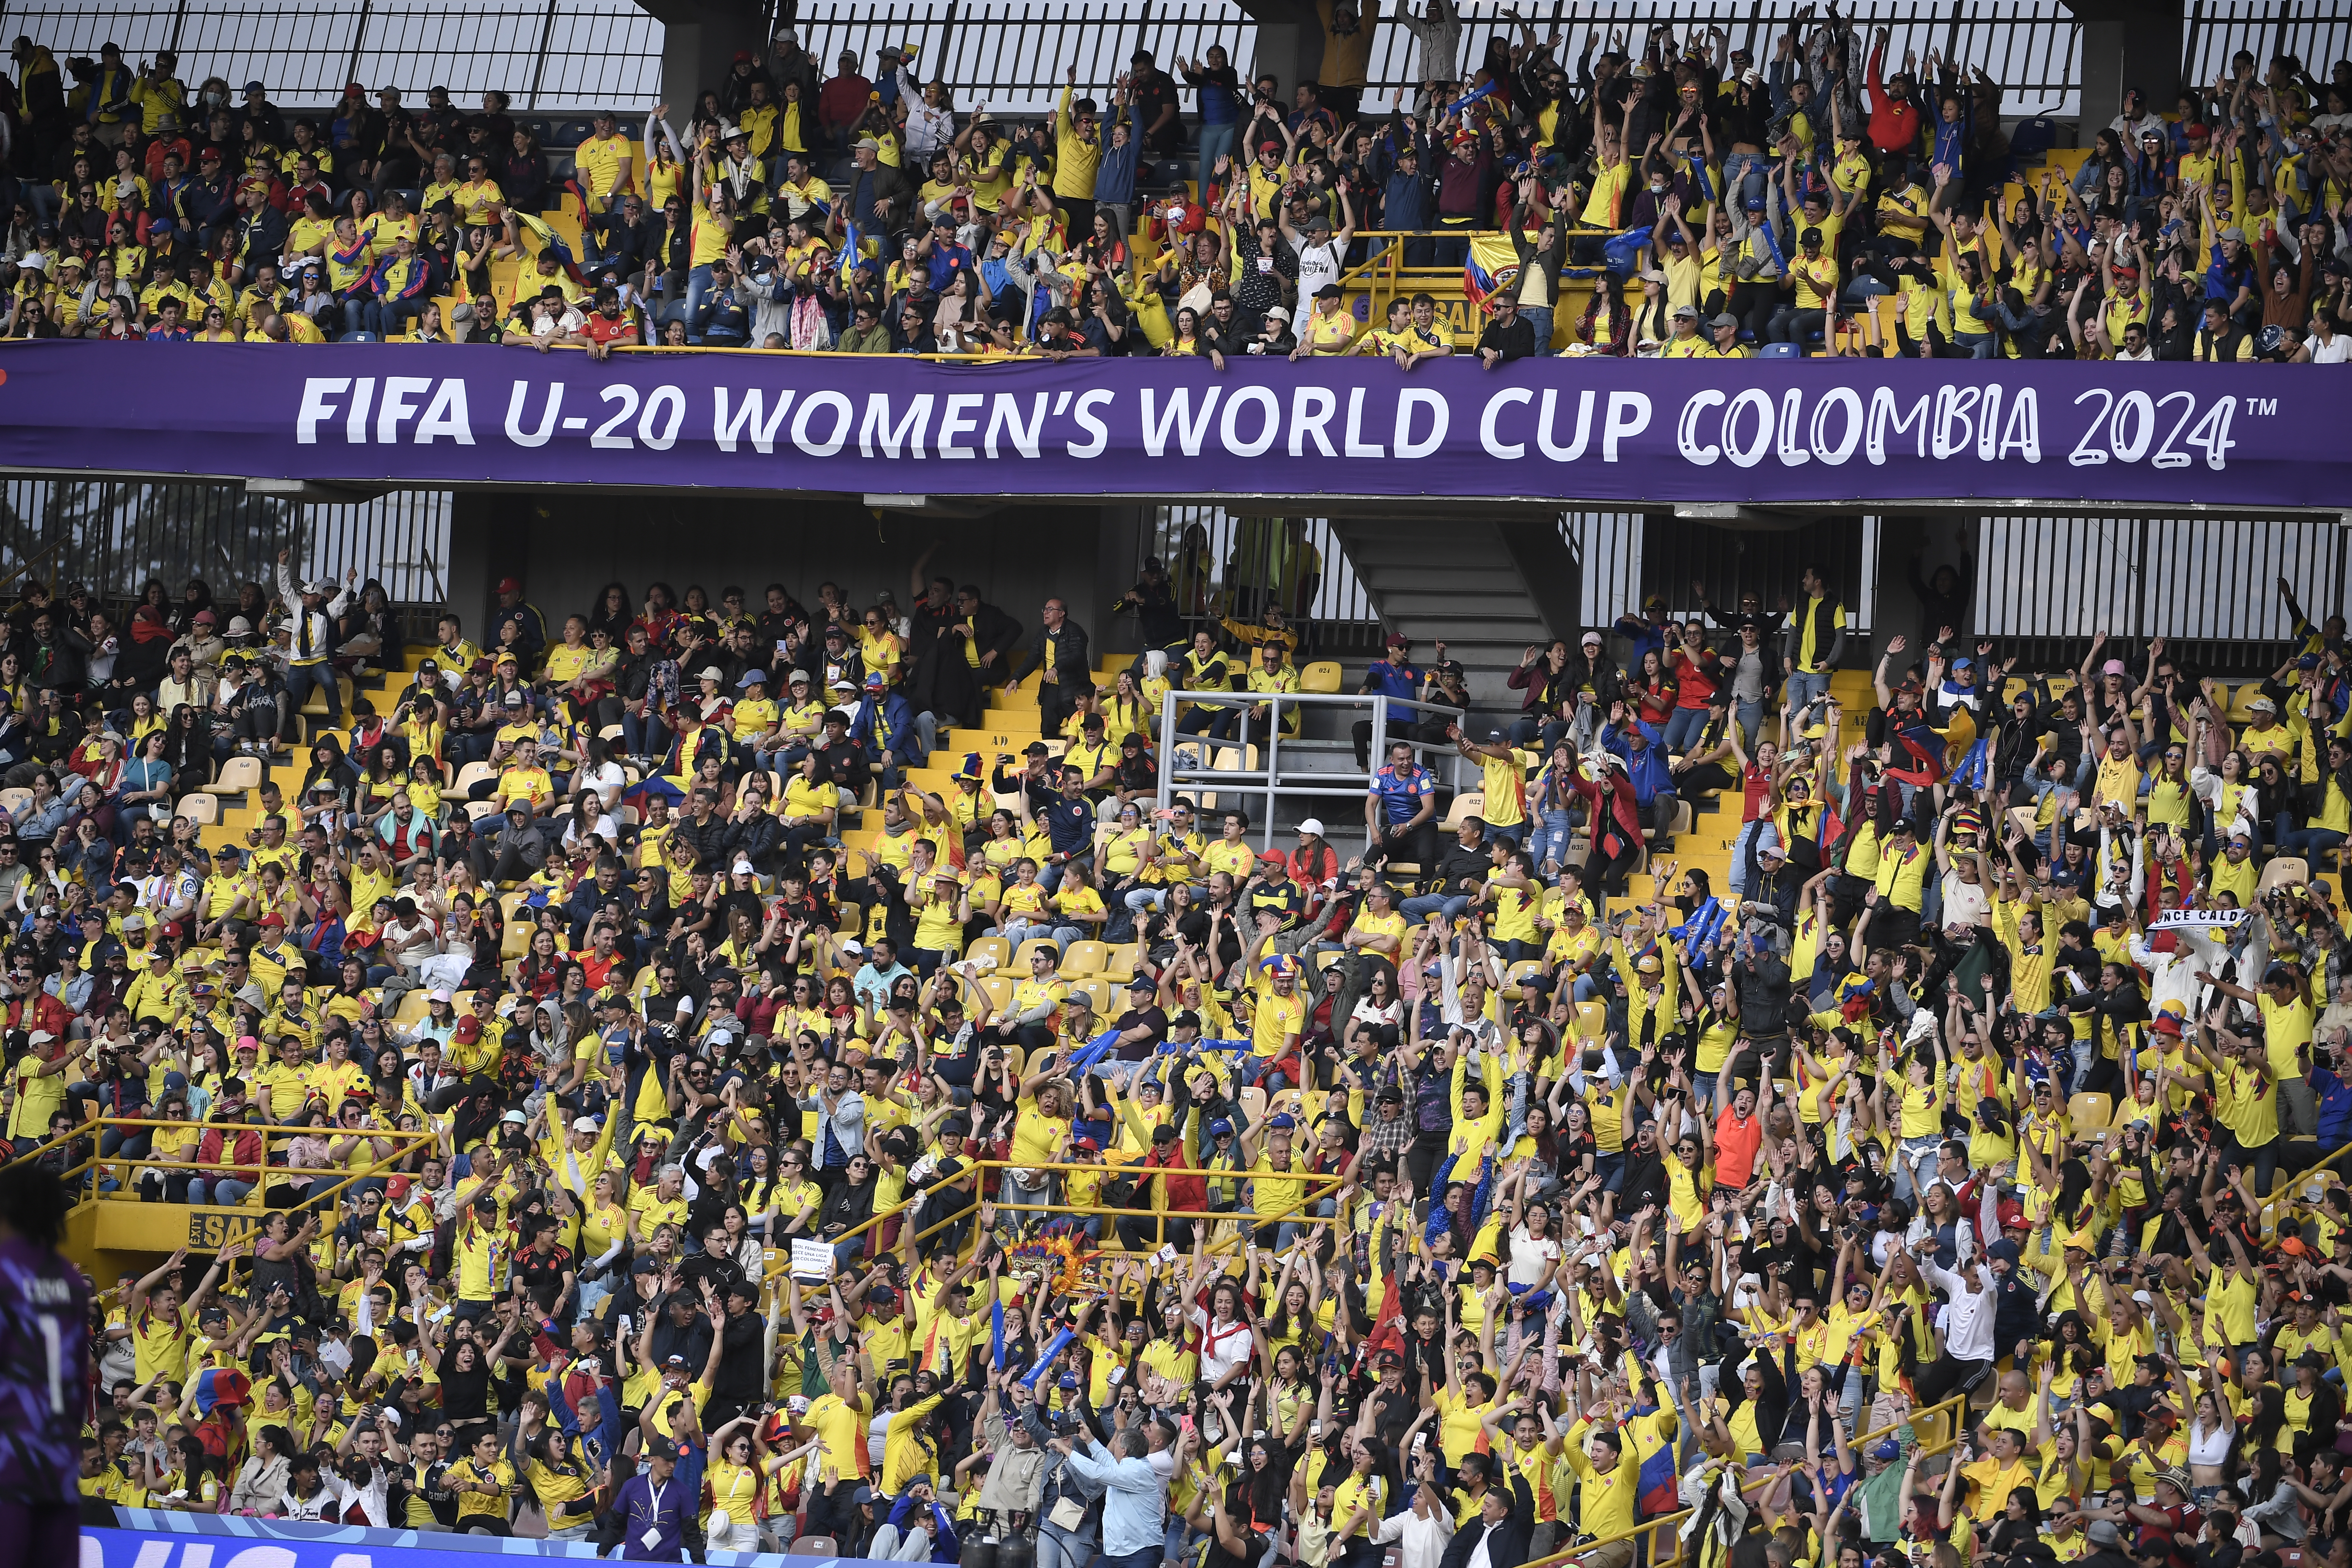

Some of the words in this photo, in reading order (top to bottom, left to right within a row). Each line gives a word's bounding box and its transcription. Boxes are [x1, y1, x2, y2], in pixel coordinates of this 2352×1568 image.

[838, 253, 846, 264] VISA
[393, 269, 400, 278] 4
[1361, 305, 1369, 316] 3
[297, 377, 476, 444] FIFA
[505, 380, 686, 450] U-20
[714, 386, 1115, 458] WOMEN'S
[1141, 386, 1449, 458] WORLD
[1480, 388, 1652, 465] CUP
[1677, 384, 2041, 467] COLOMBIA
[1699, 911, 1707, 923] VISA
[2199, 910, 2251, 922] CALD
[191, 1214, 202, 1245] EXIT
[1033, 1358, 1045, 1369] VISA
